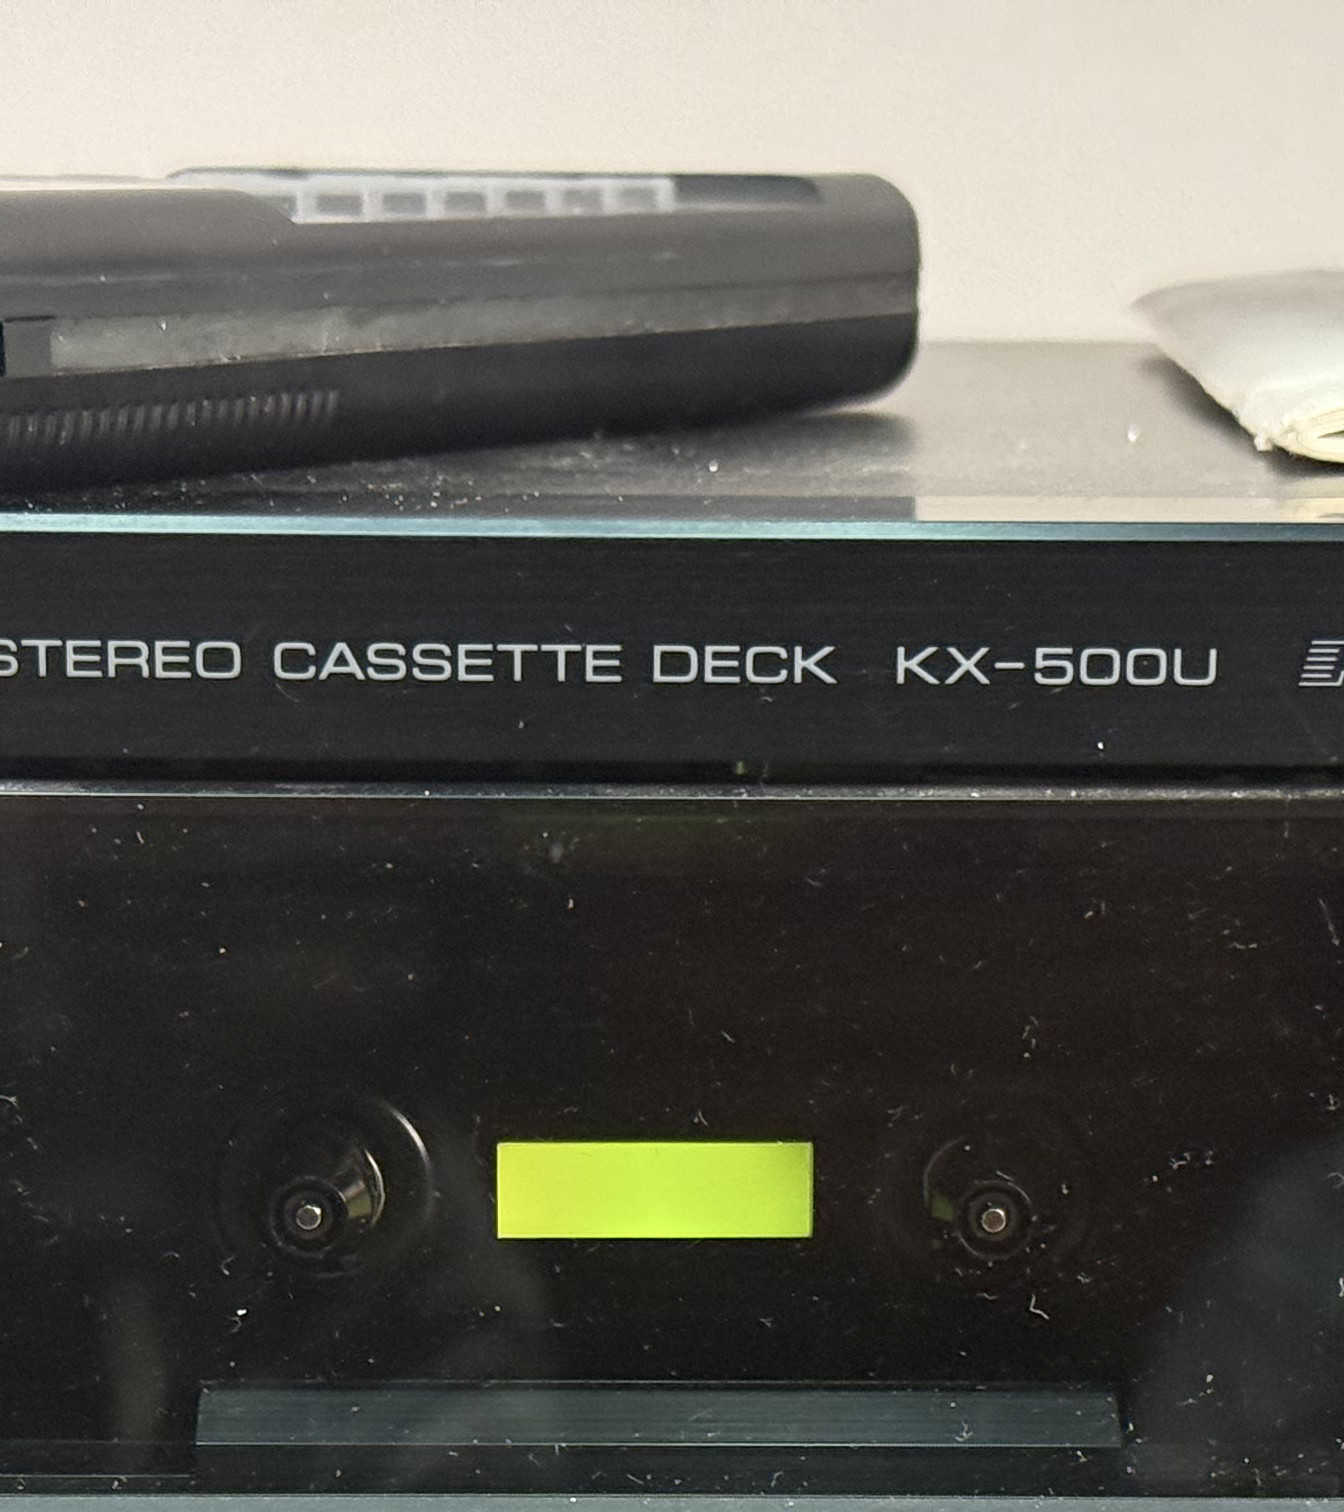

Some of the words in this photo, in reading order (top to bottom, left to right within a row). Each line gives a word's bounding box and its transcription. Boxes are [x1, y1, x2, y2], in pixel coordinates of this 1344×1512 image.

[273, 641, 623, 683] CASSETTE
[652, 644, 837, 684] DECK
[896, 646, 1218, 686] KX-500U
